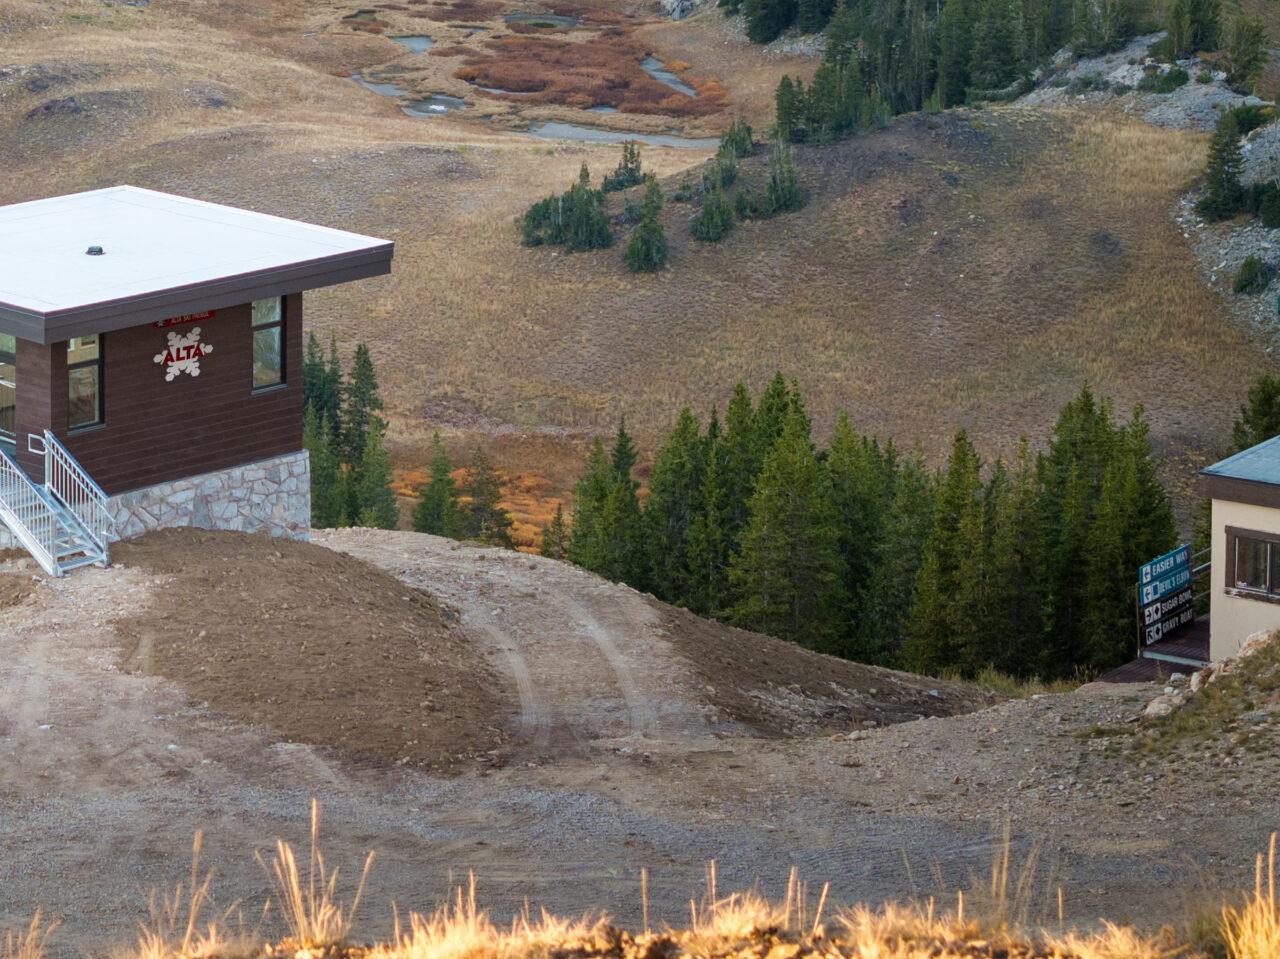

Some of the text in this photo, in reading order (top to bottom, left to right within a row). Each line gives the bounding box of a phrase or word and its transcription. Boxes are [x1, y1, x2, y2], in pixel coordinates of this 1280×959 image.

[161, 343, 204, 366] ALTA
[1152, 551, 1188, 576] EASIER WAY
[1161, 590, 1192, 614] SUGAR BOWL
[1162, 617, 1179, 634] GRAVY
